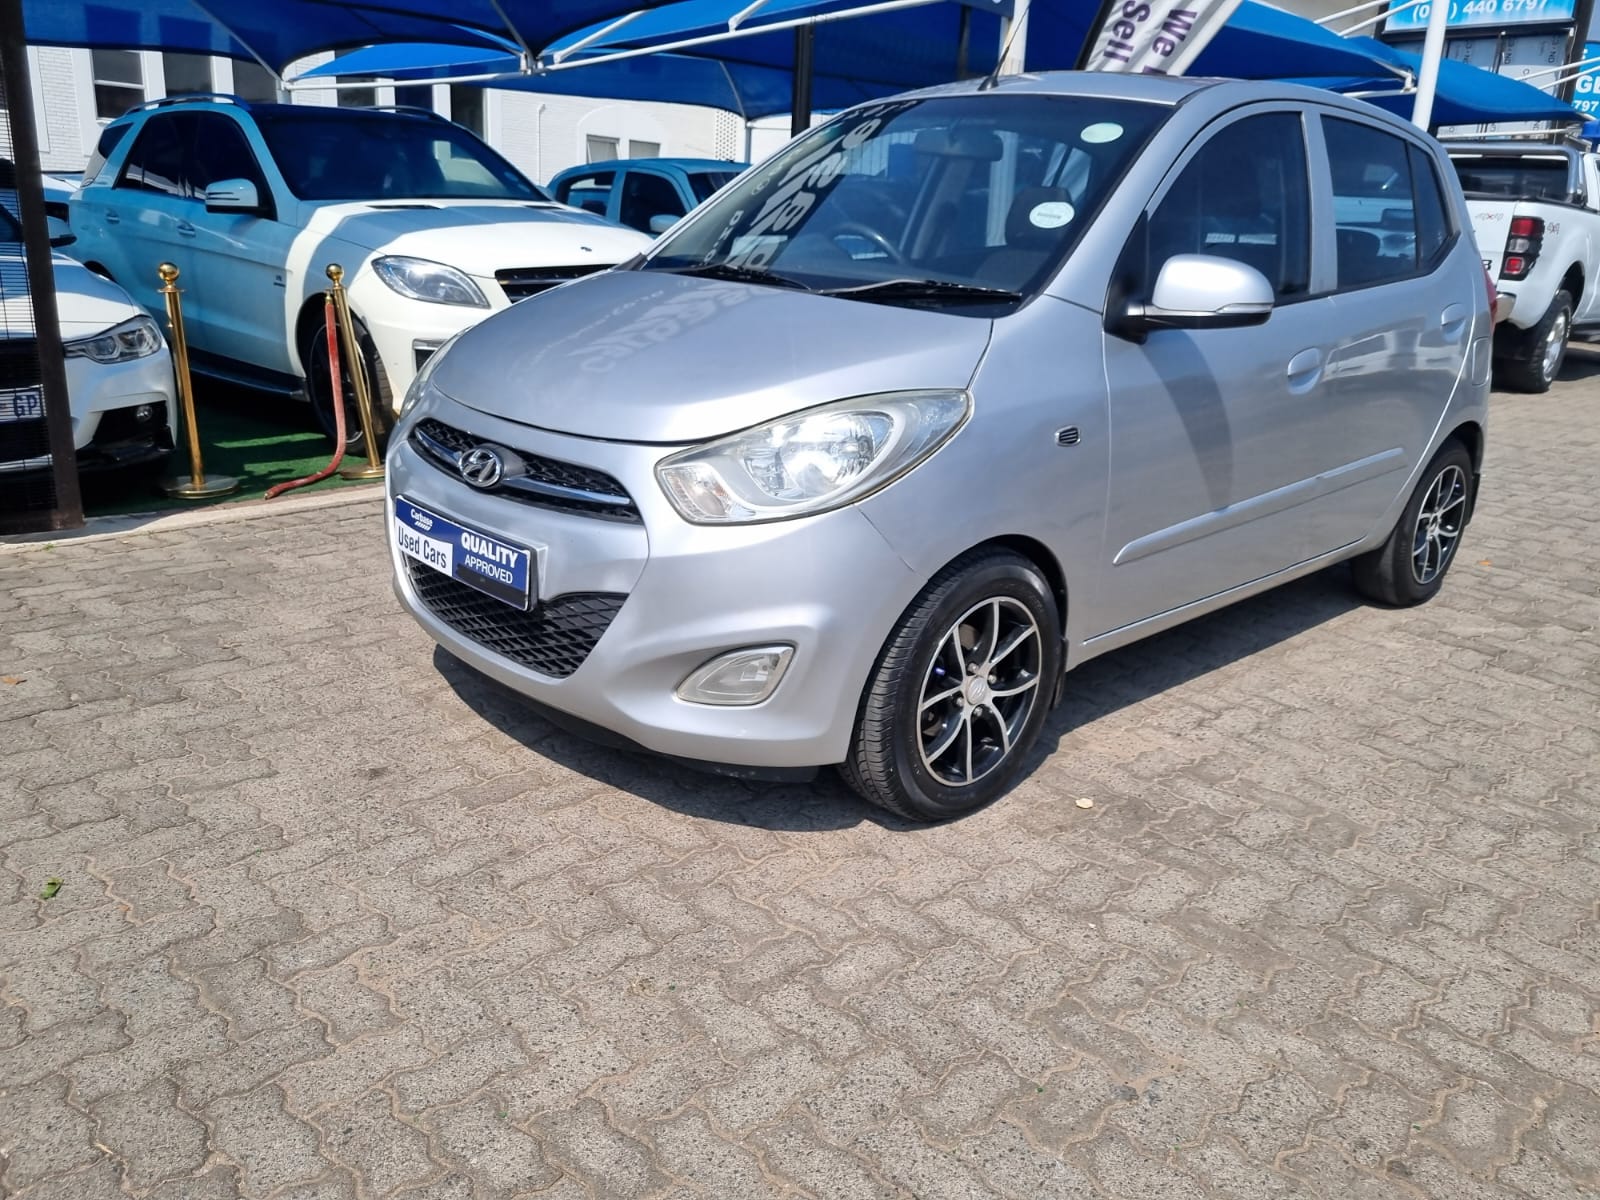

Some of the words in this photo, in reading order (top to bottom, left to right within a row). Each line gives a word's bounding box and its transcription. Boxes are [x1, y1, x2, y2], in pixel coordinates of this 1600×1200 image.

[1462, 0, 1498, 14] 440
[1103, 0, 1151, 63] Sell
[1151, 8, 1198, 57] We
[398, 526, 420, 555] Used
[423, 539, 447, 569] Cars
[461, 531, 519, 569] QUALITY
[464, 554, 513, 584] APPROVED
